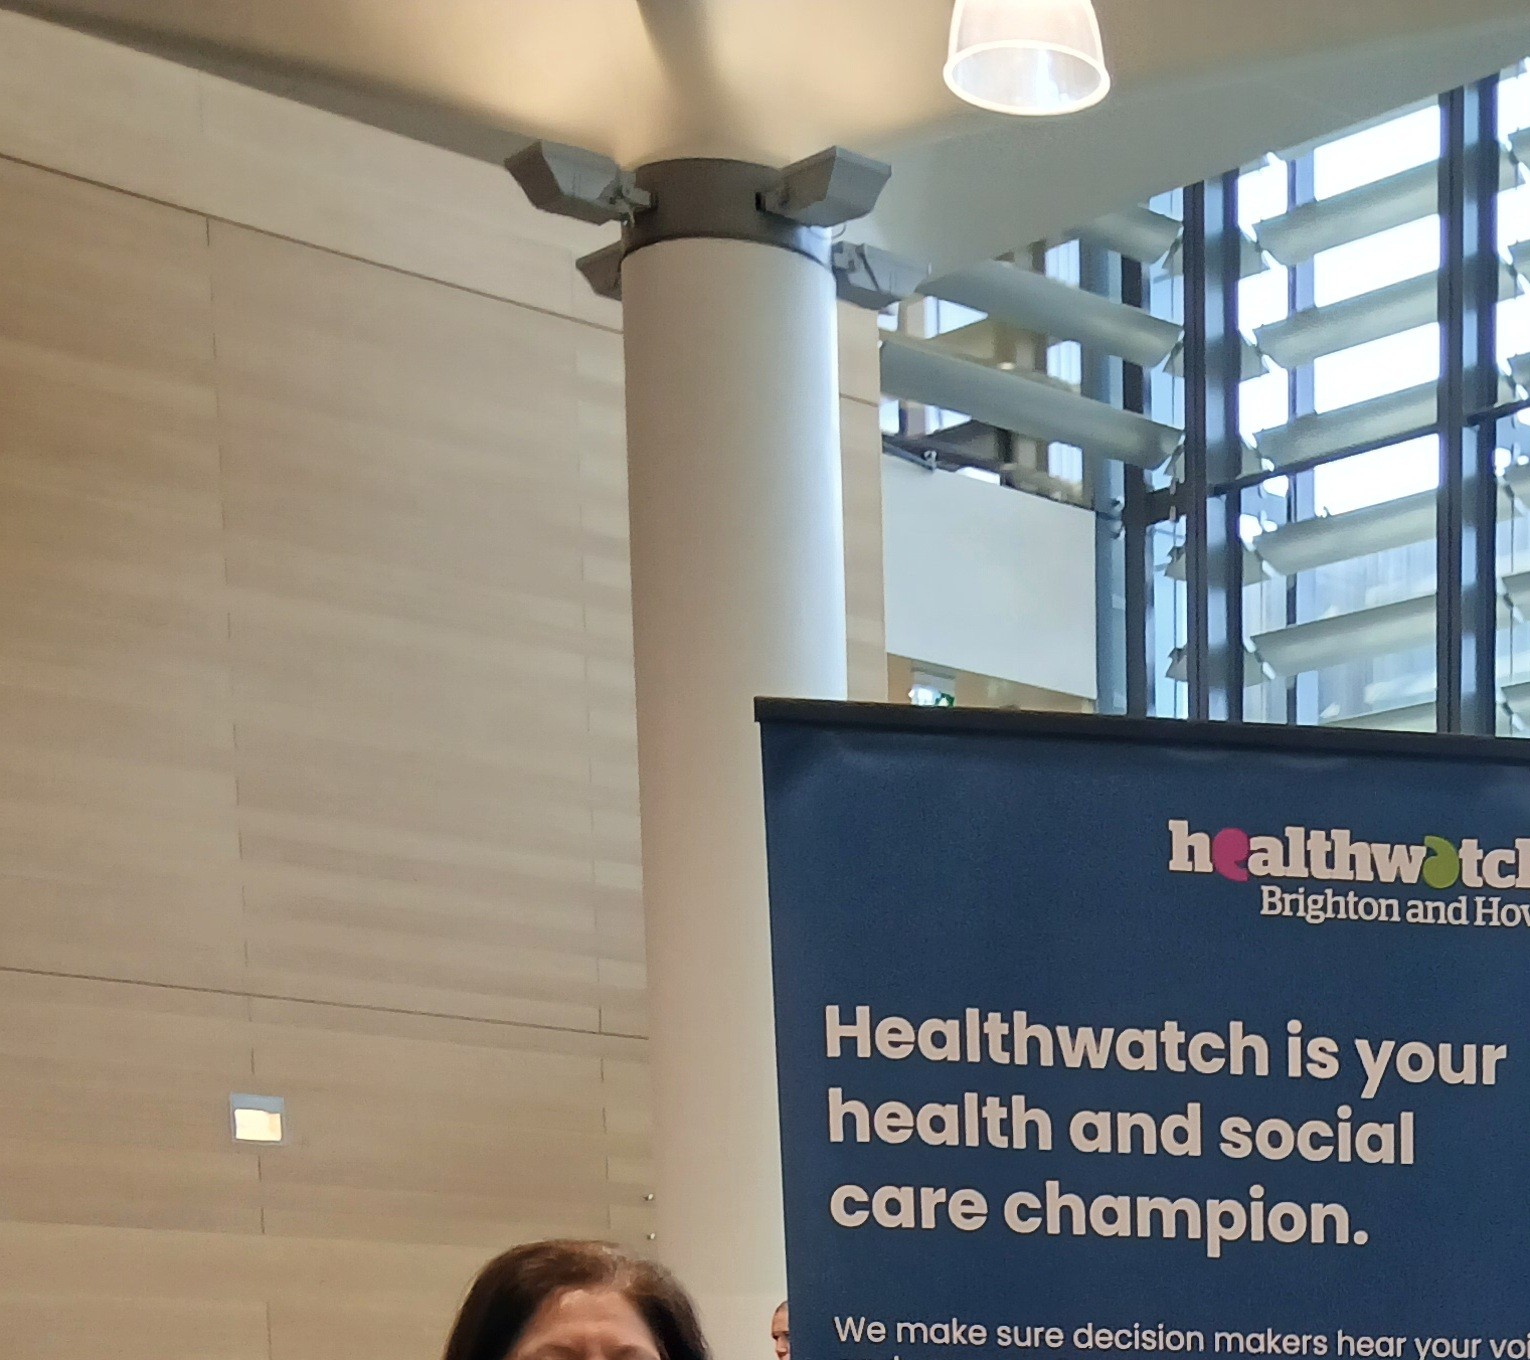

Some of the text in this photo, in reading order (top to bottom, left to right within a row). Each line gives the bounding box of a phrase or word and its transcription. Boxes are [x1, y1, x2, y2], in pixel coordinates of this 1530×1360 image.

[1260, 885, 1401, 925] Brighton
[1405, 896, 1468, 926] and
[823, 1005, 1508, 1099] Healthwatch is your
[827, 1088, 1416, 1166] health and social
[829, 1181, 1369, 1259] care champion.
[834, 1316, 888, 1345] We
[895, 1318, 989, 1349] make
[996, 1328, 1065, 1351] sure
[1072, 1321, 1206, 1354] decision
[1213, 1325, 1329, 1357] makers
[1336, 1329, 1407, 1357] hear
